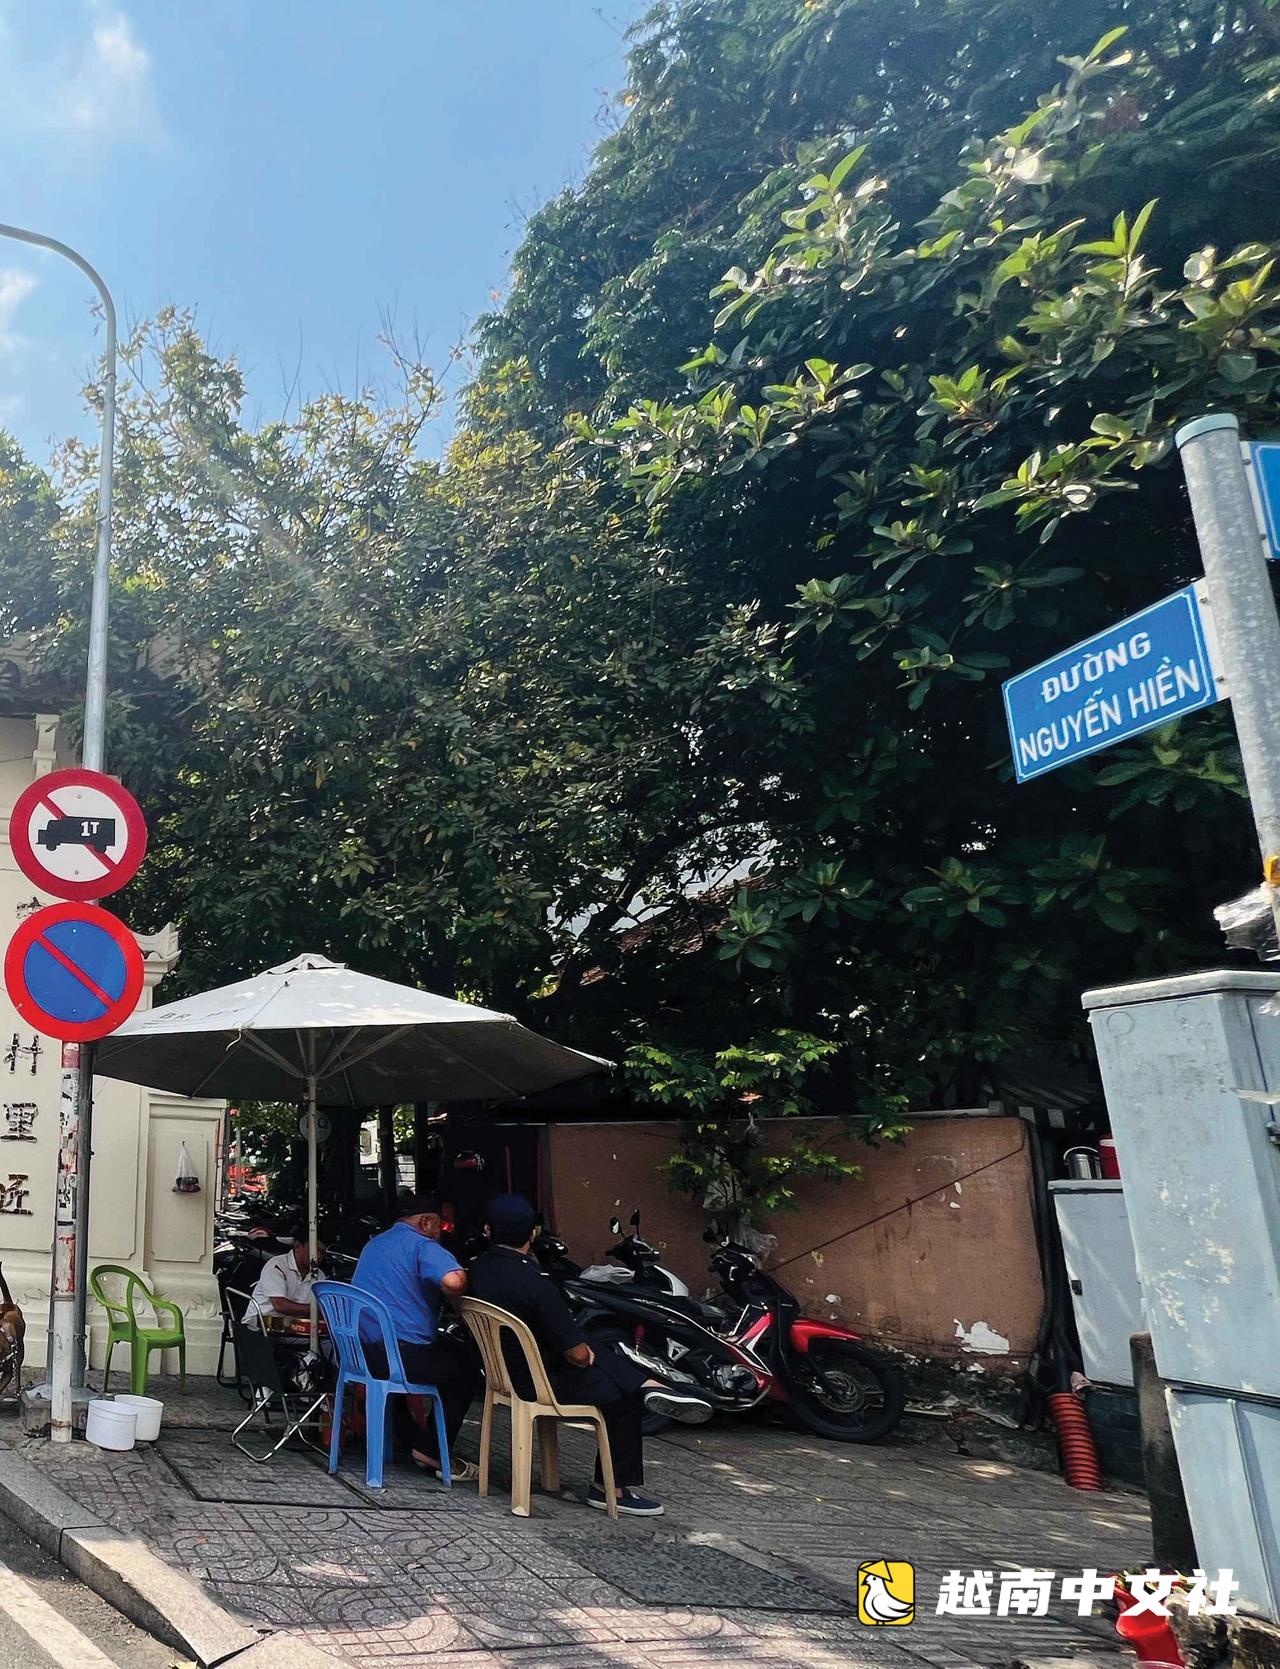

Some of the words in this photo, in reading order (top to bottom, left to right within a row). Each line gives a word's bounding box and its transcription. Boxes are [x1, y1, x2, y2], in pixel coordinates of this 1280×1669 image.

[1041, 632, 1151, 703] ĐƯỜNG
[1020, 687, 1122, 766] NGUYỄN
[1128, 656, 1200, 719] HIỀN
[81, 821, 100, 837] 1T
